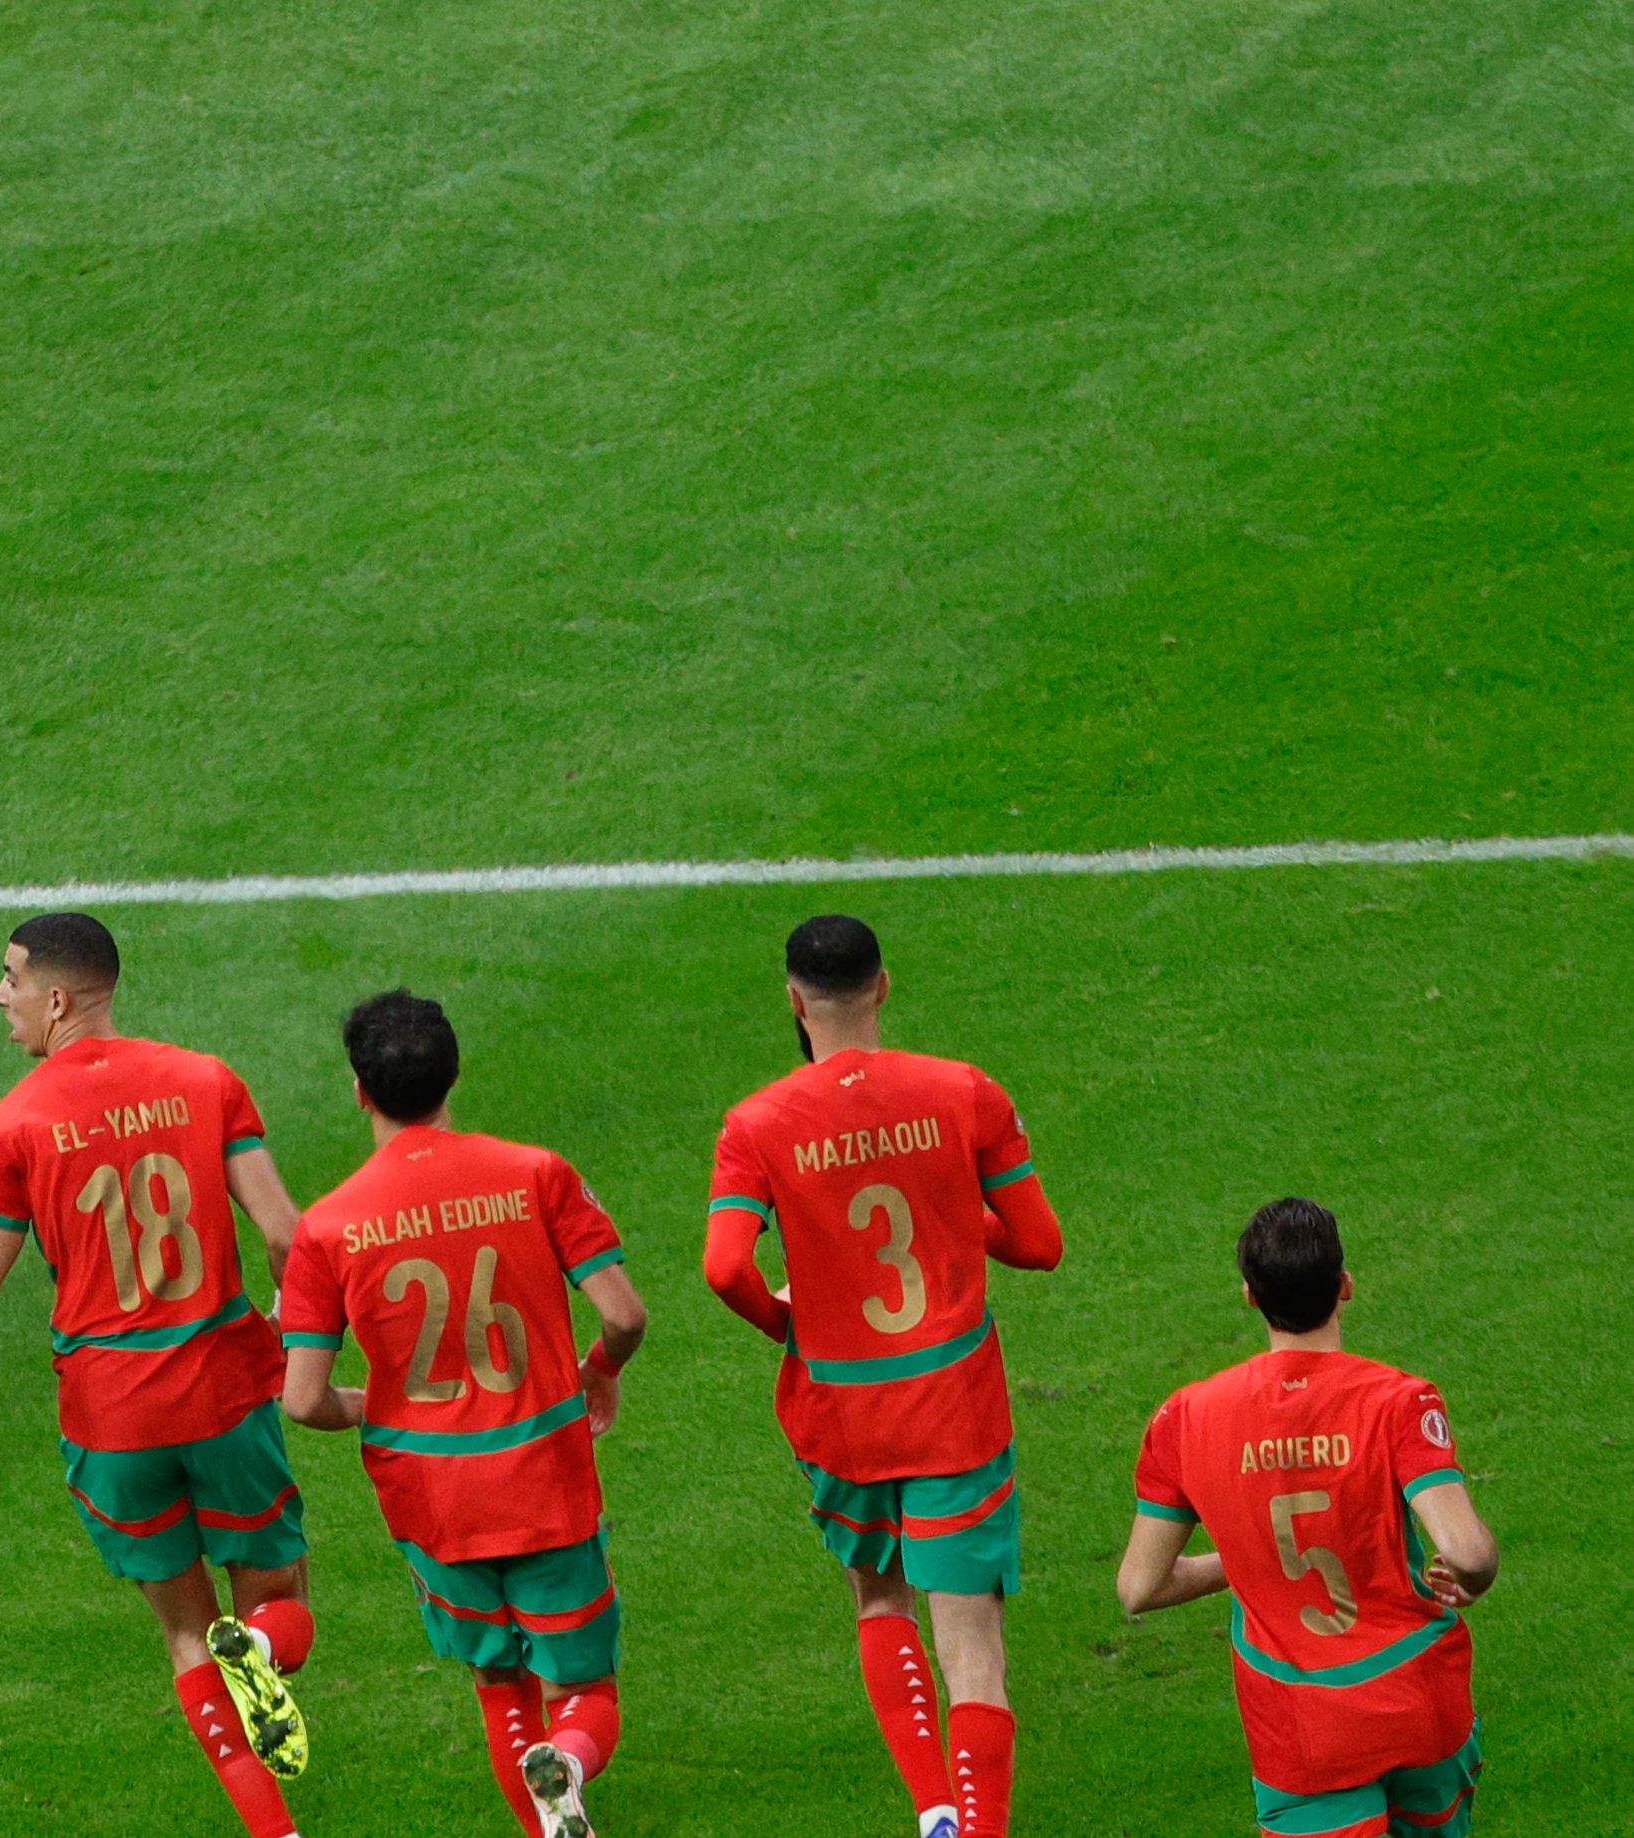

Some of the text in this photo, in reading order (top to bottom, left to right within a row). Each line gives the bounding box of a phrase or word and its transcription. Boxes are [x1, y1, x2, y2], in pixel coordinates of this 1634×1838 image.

[793, 1117, 942, 1174] MAZRAOUI
[76, 1152, 204, 1312] 18
[343, 1189, 532, 1254] SALAH EDDINE
[848, 1183, 927, 1334] 3
[383, 1246, 528, 1402] 26
[1240, 1434, 1351, 1474] AGUERD
[1269, 1490, 1358, 1636] 5
